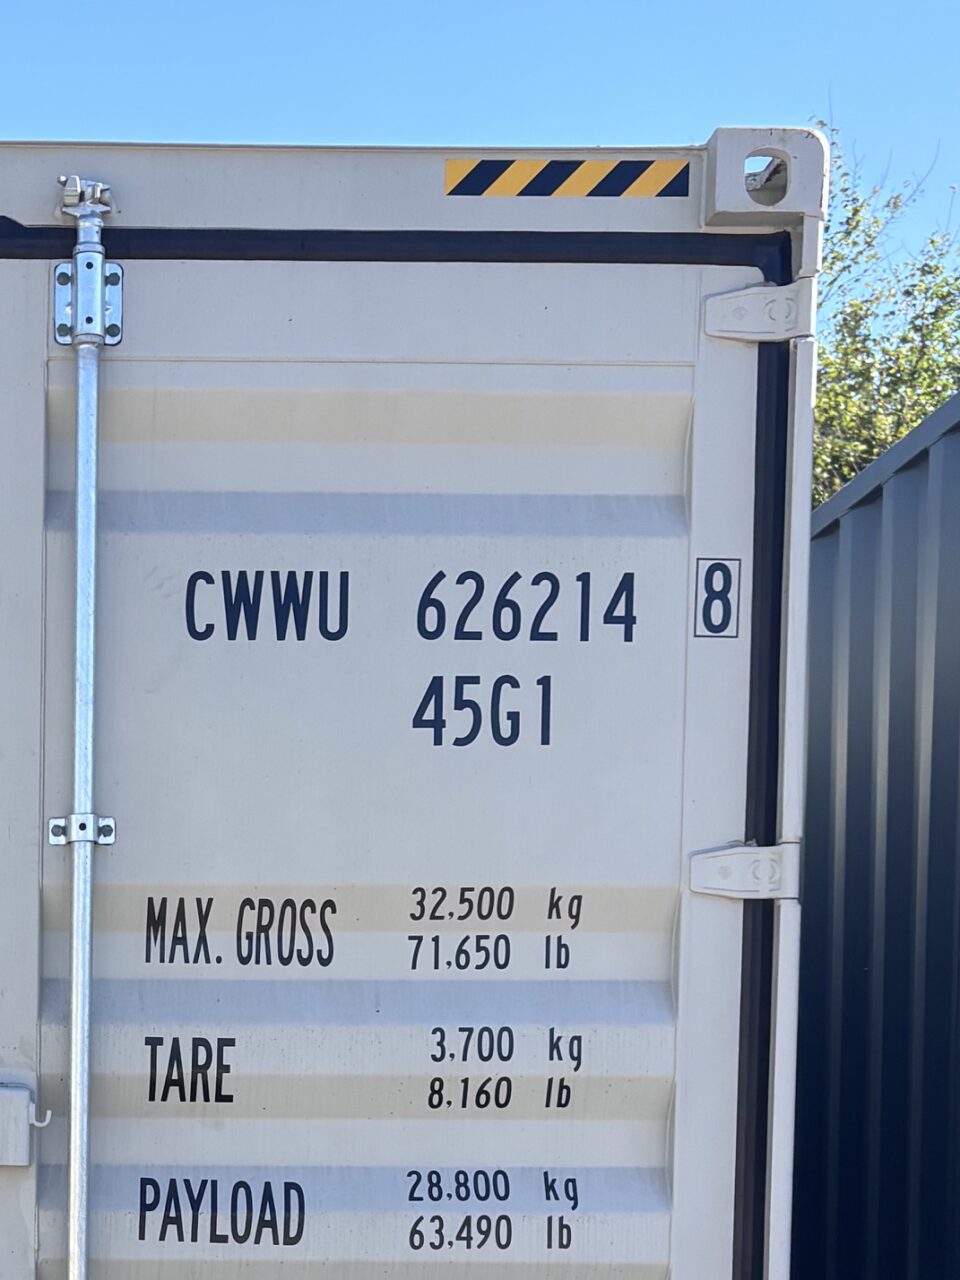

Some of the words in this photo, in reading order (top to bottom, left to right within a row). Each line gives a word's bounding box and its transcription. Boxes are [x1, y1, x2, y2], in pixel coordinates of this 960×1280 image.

[185, 570, 349, 642] CWWU
[416, 570, 637, 643] 626214
[701, 561, 733, 634] 8
[412, 674, 552, 747] 45G1
[409, 886, 515, 921] 32,500
[547, 887, 583, 930] kg
[145, 896, 223, 964] MAX.
[236, 897, 337, 968] GROSS
[407, 934, 511, 970] 71,650
[545, 934, 570, 969] lb
[144, 1036, 236, 1103] TARE
[430, 1026, 514, 1063] 3,700
[549, 1027, 582, 1073] kg
[427, 1076, 512, 1110] 8,160
[545, 1077, 571, 1108] lb
[138, 1177, 306, 1246] PAYLOAD
[406, 1169, 510, 1202] 28,800
[543, 1170, 579, 1211] kg
[409, 1214, 512, 1251] 63,490
[547, 1215, 572, 1250] lb
